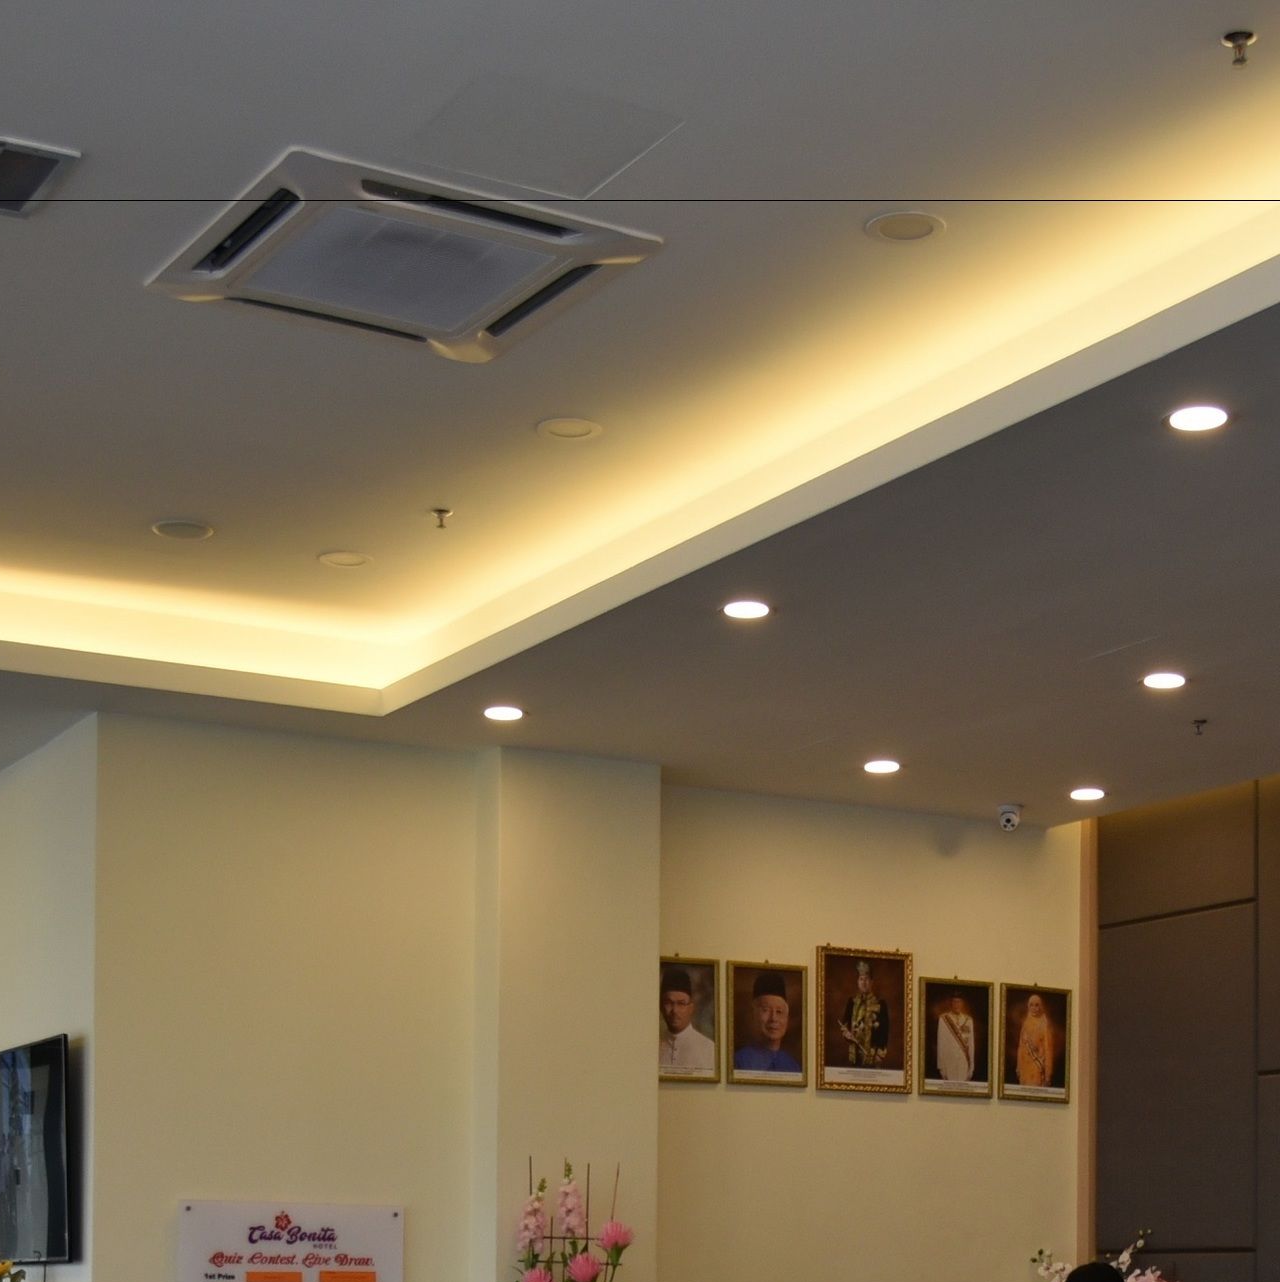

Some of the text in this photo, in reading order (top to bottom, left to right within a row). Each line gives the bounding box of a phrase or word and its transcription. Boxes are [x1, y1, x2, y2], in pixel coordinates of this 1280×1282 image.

[248, 1226, 337, 1245] Casa Bonita
[209, 1251, 243, 1268] Quiz
[302, 1252, 332, 1268] Live
